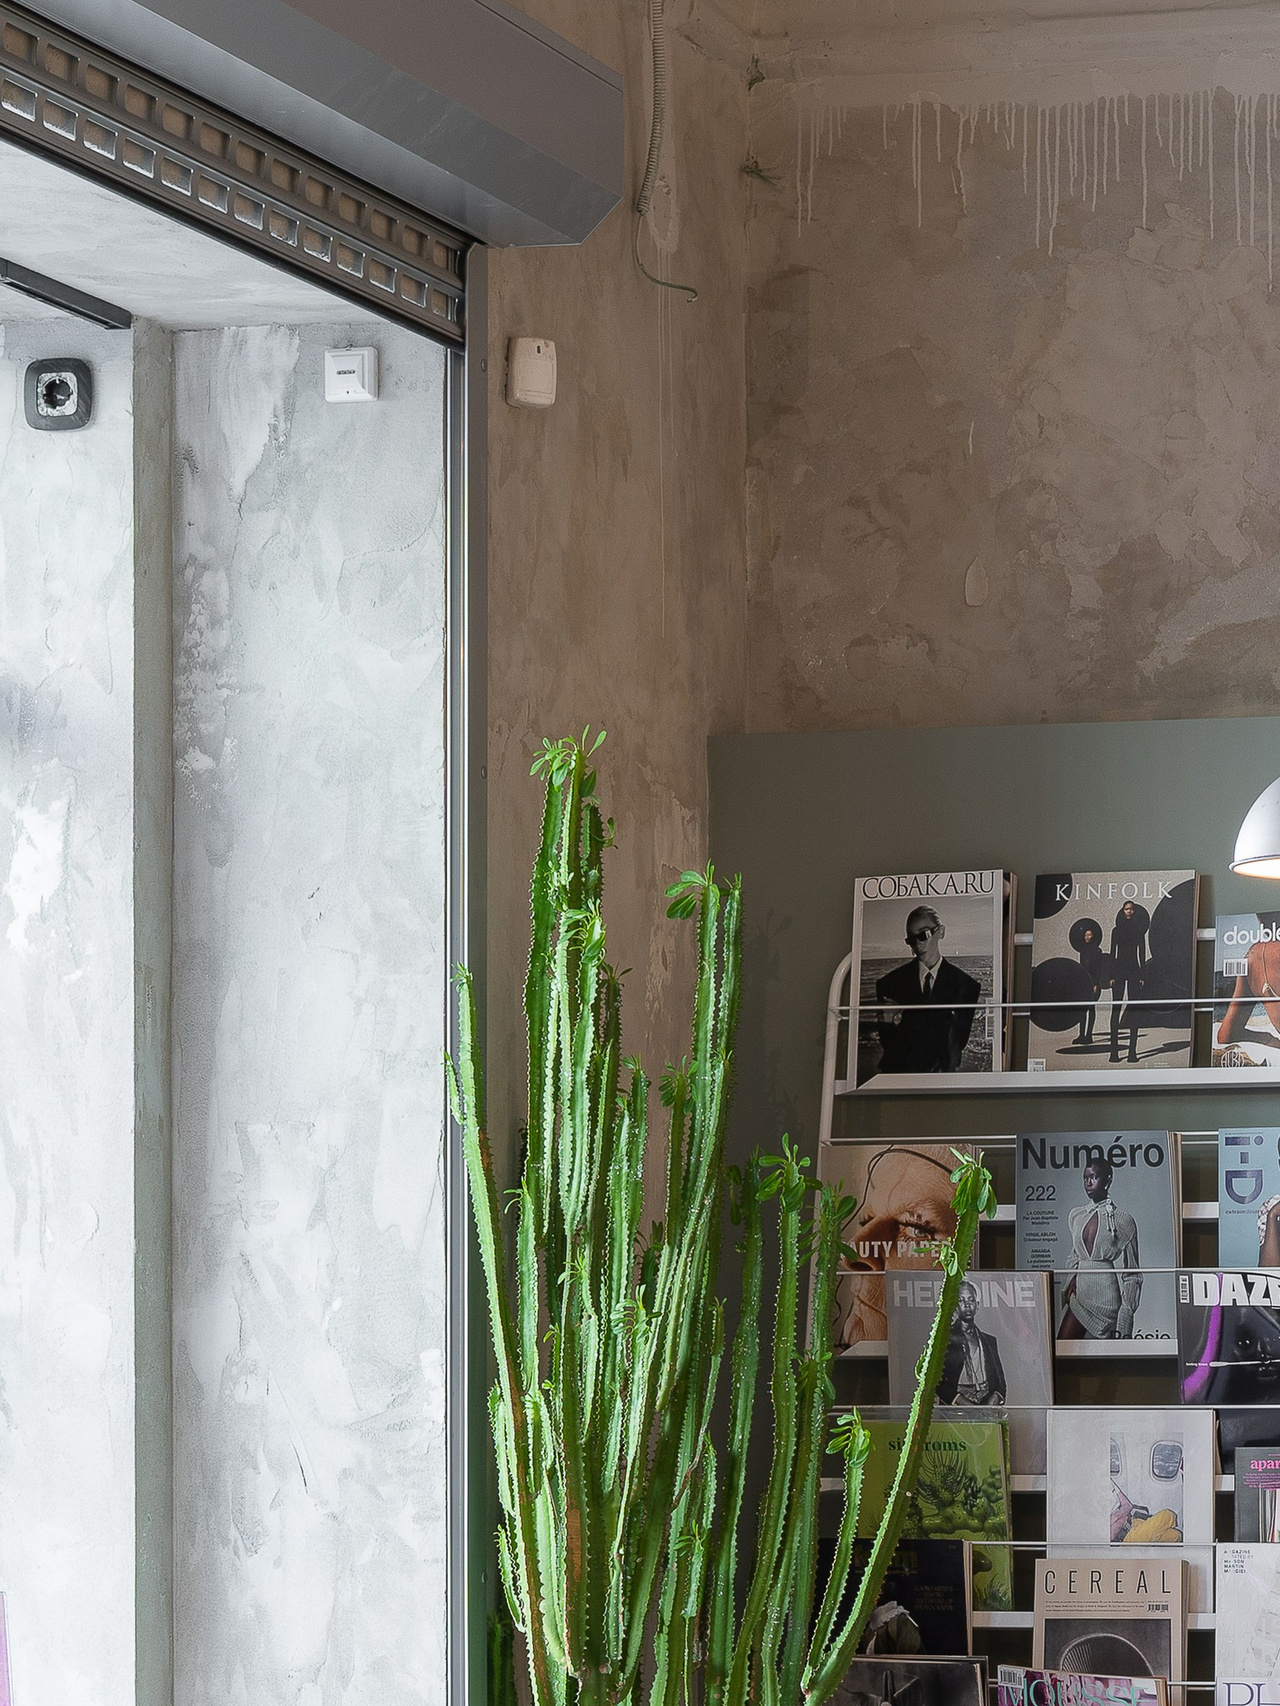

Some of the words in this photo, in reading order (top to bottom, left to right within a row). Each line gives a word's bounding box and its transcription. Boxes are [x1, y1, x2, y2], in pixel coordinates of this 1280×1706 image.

[1056, 881, 1173, 901] KINFOLK
[1022, 1135, 1165, 1170] Numéro
[1025, 1185, 1056, 1201] 222
[1044, 1570, 1171, 1594] CEREAL
